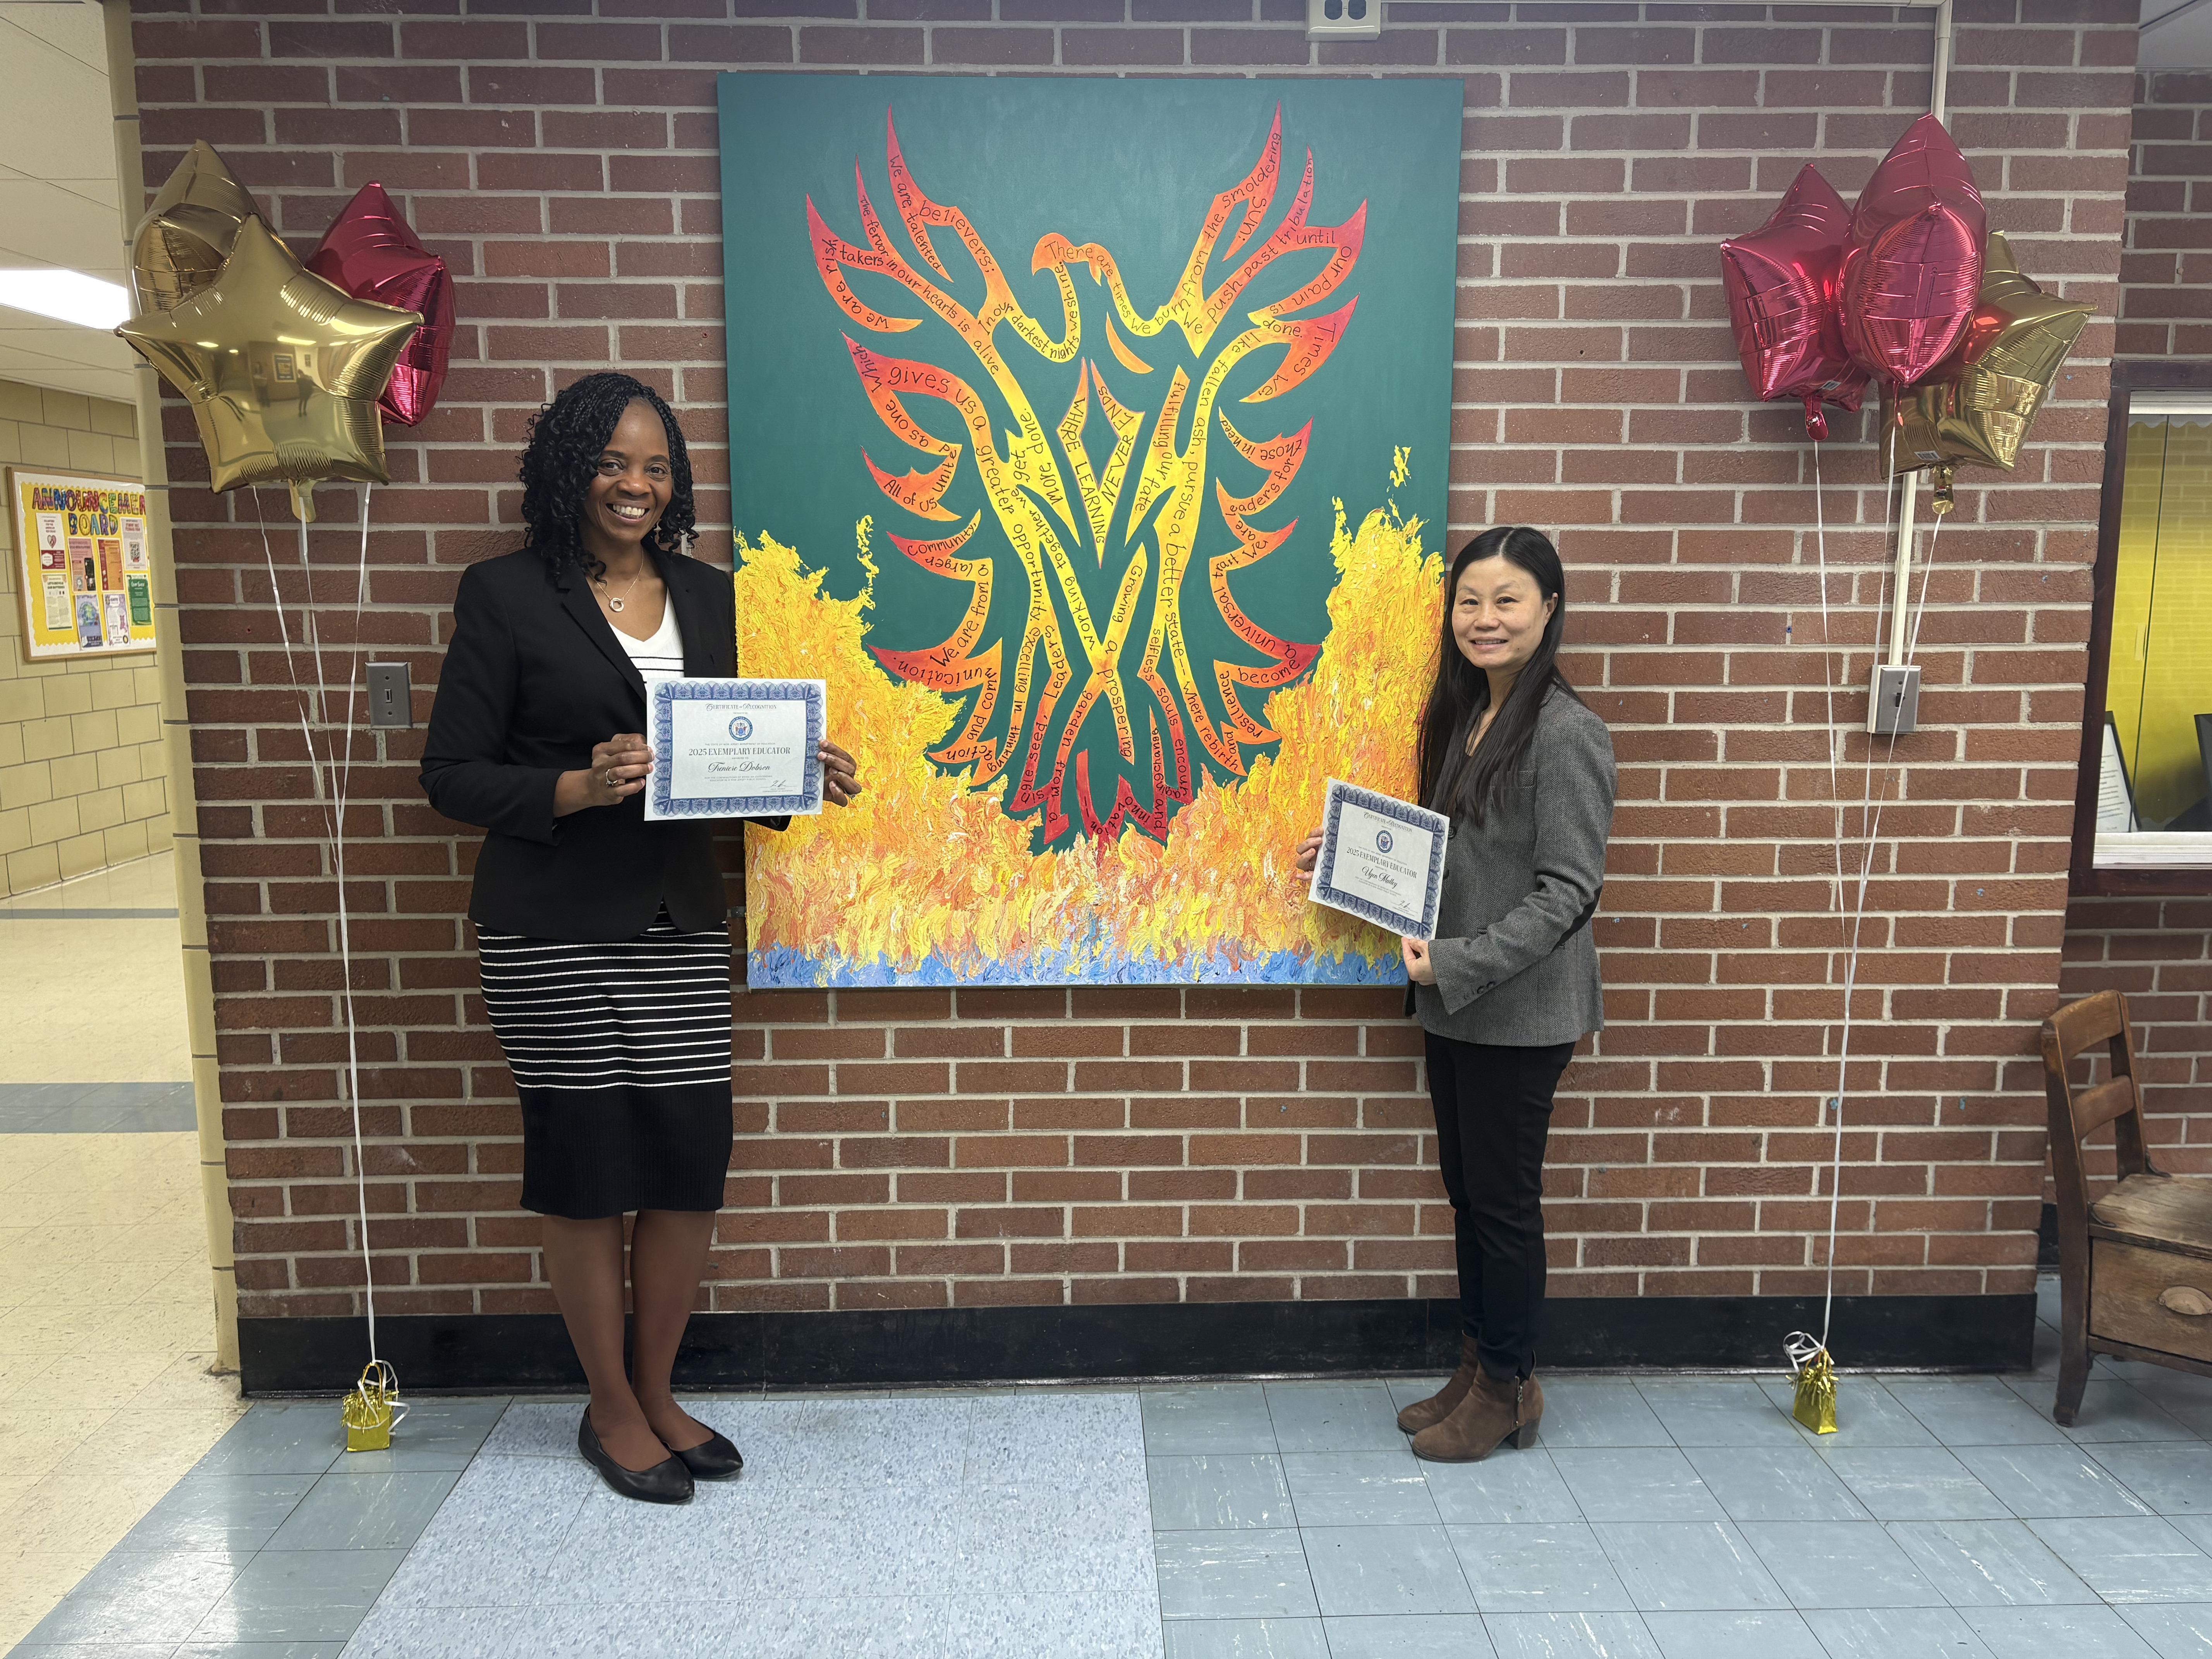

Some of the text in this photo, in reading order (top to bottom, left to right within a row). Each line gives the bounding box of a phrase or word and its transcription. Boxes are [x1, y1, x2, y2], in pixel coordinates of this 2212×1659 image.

[890, 155, 902, 177] We
[897, 183, 911, 208] are
[907, 212, 941, 270] talented
[1045, 241, 1092, 259] There
[1097, 254, 1113, 277] are
[1113, 282, 1131, 318] times
[1131, 318, 1150, 334] We
[1154, 299, 1191, 326] burn
[1182, 251, 1208, 297] from
[1204, 213, 1224, 240] the
[1223, 132, 1281, 208] smoldering
[1183, 158, 1352, 338] We push past tribulation until our pain is done.
[840, 245, 884, 266] takers
[836, 280, 861, 313] are
[860, 195, 999, 375] The fervor in our hearts is alive
[1054, 261, 1076, 307] shine.
[867, 313, 889, 329] We
[993, 302, 1014, 317] our
[978, 318, 996, 335] In
[1012, 316, 1049, 353] darkest
[1050, 335, 1079, 359] nights
[1232, 332, 1261, 353] like
[1294, 323, 1336, 376] Times
[888, 366, 950, 393] gives
[1200, 359, 1228, 407] fallen
[886, 399, 908, 430] one
[973, 416, 986, 431] a
[1153, 381, 1185, 447] fulfilling
[909, 430, 929, 448] as
[1020, 408, 1044, 454] done.
[1190, 417, 1206, 454] ash,
[1061, 386, 1134, 543] WHERE LEARNING NEVER ENDS
[1242, 443, 1255, 459] in
[1260, 439, 1302, 460] those
[932, 444, 957, 493] united
[975, 445, 1015, 515] greater
[1011, 449, 1030, 483] get
[1156, 452, 1172, 481] our
[1274, 458, 1294, 481] for
[883, 479, 902, 498] All
[903, 492, 916, 505] of
[1039, 462, 1064, 506] more
[1173, 460, 1198, 520] pursue
[1225, 483, 1281, 516] leaders
[68, 513, 118, 536] BOARD
[1029, 510, 1066, 569] together
[1169, 524, 1180, 537] a
[1235, 520, 1255, 540] are
[1242, 540, 1268, 559] We
[925, 556, 973, 577] larger
[978, 564, 989, 576] a
[1013, 524, 1047, 622] opportunity.
[1160, 543, 1187, 608] better
[1212, 554, 1239, 579] trait
[971, 581, 989, 616] from
[1065, 576, 1096, 651] working
[957, 620, 979, 647] are
[1214, 586, 1276, 651] universal
[930, 647, 959, 667] We
[1015, 627, 1041, 693] excelling
[1096, 565, 1142, 757] Growing a prospering
[1143, 628, 1161, 681] selfless
[1285, 645, 1297, 658] a
[1239, 659, 1300, 684] become
[1014, 701, 1025, 713] in
[1061, 690, 1093, 747] garden
[1156, 687, 1178, 726] souls
[1219, 671, 1263, 738] resilience
[967, 714, 986, 740] and
[1029, 715, 1047, 762] seed,
[1224, 731, 1237, 754] and
[709, 747, 751, 756] EXEMPLARY
[946, 745, 993, 761] action
[988, 725, 1020, 772] thinking
[1152, 727, 1162, 772] change
[1200, 726, 1239, 771] rebirth
[739, 761, 771, 771] Dobson
[1051, 760, 1066, 797] from
[1049, 812, 1058, 823] a
[1154, 799, 1166, 830] and
[1364, 811, 1412, 833] CERTIFICATE RECOGNITION
[1346, 847, 1359, 857] 2025
[1360, 851, 1389, 868] EXEMPLARY
[1390, 862, 1417, 878] EDUCATOR
